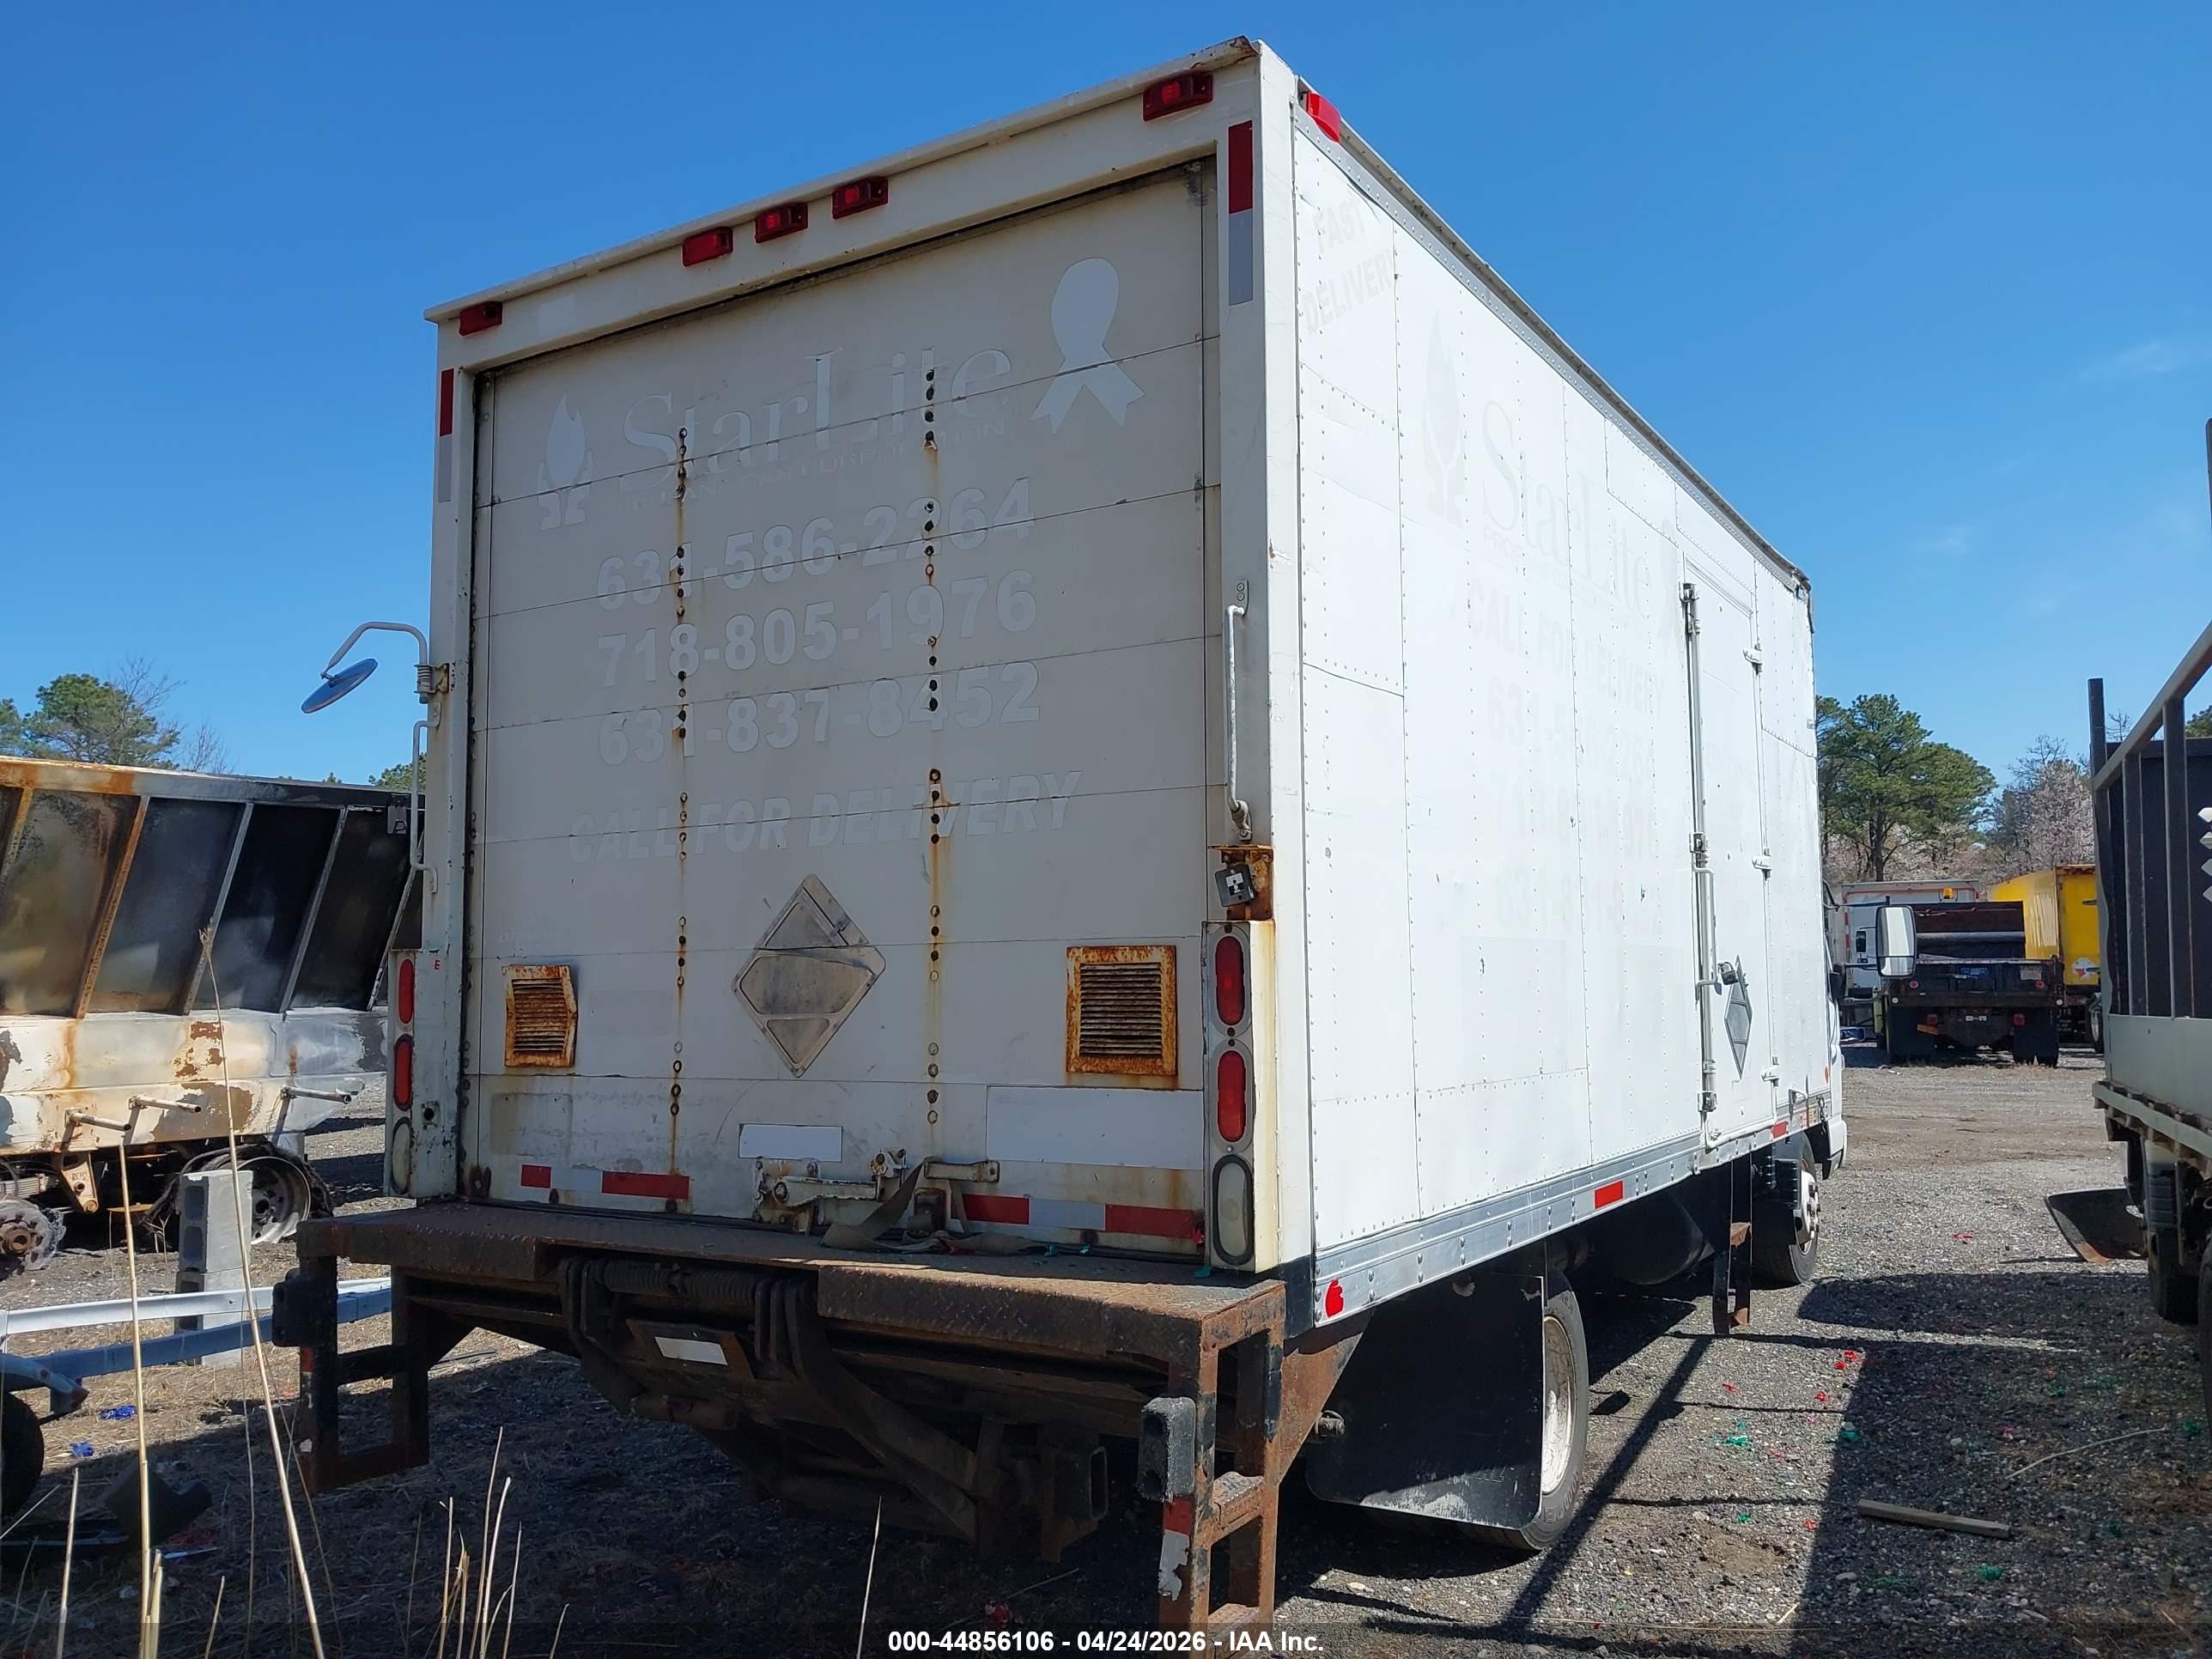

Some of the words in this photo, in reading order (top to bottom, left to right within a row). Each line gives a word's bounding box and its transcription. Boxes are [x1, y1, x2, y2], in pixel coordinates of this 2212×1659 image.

[1313, 198, 1364, 254] FAST
[595, 476, 1036, 611] 631-586-2264
[597, 568, 1038, 687] 718-805-1976
[597, 660, 1042, 767] 631-837-8452
[569, 806, 684, 863] CALL
[694, 796, 792, 856] FOR
[810, 770, 1085, 848] DELIVERY
